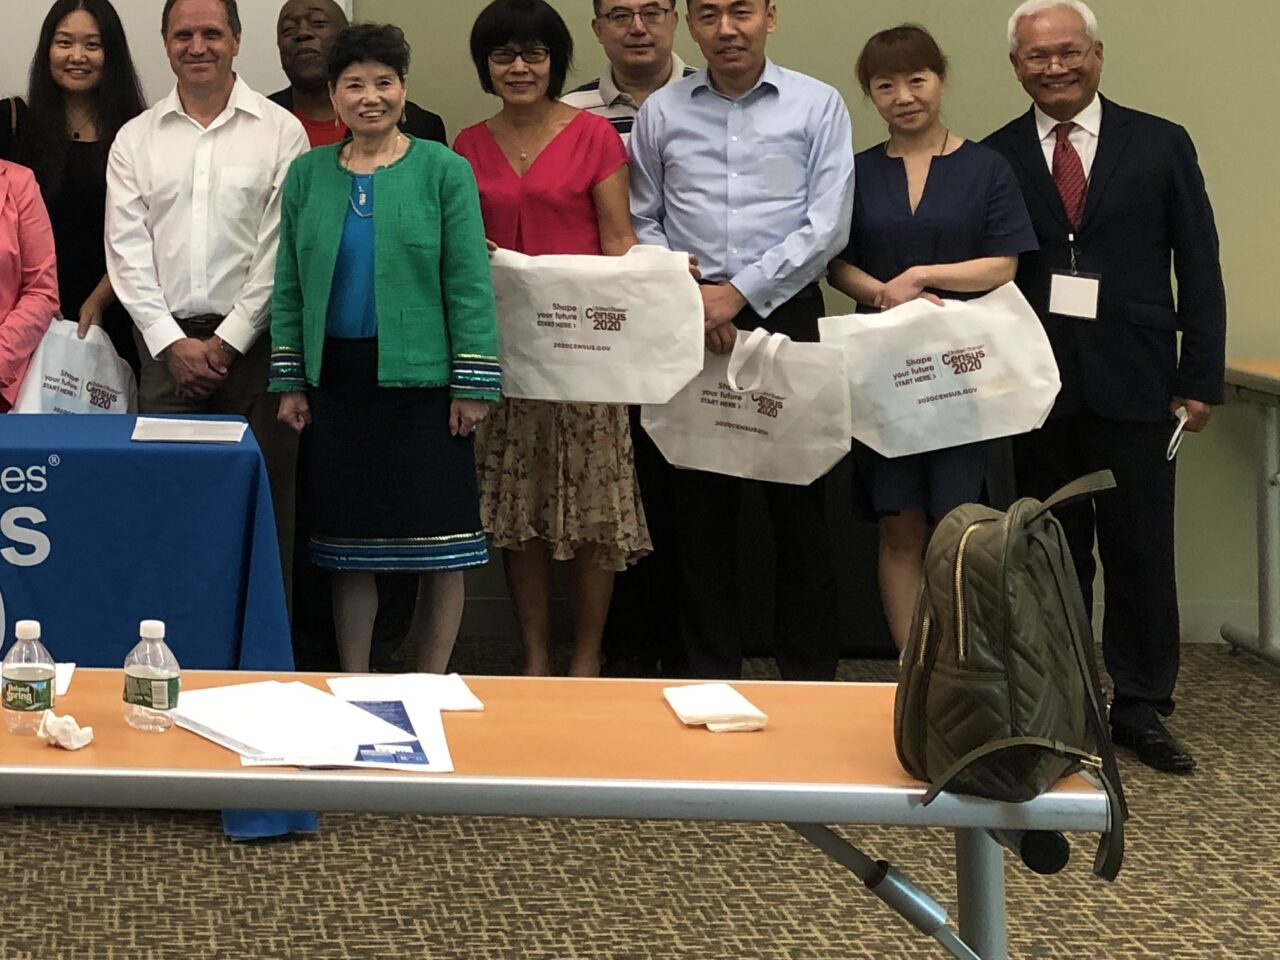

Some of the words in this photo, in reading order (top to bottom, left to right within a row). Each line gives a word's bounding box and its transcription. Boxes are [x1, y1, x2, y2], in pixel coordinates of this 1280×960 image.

[552, 303, 577, 312] Shape
[555, 312, 577, 320] future
[586, 308, 626, 320] Census
[593, 320, 621, 331] 2020
[906, 356, 932, 366] Shape
[942, 350, 986, 366] Census
[892, 372, 909, 380] your
[911, 365, 934, 374] future
[952, 359, 982, 375] 2020
[60, 370, 79, 382] Shape
[895, 378, 913, 388] START
[914, 374, 931, 384] HERE
[42, 382, 60, 391] START
[61, 378, 78, 390] future
[86, 381, 118, 402] Census
[720, 392, 742, 400] future
[90, 396, 111, 410] 2020
[6, 690, 32, 704] Spring
